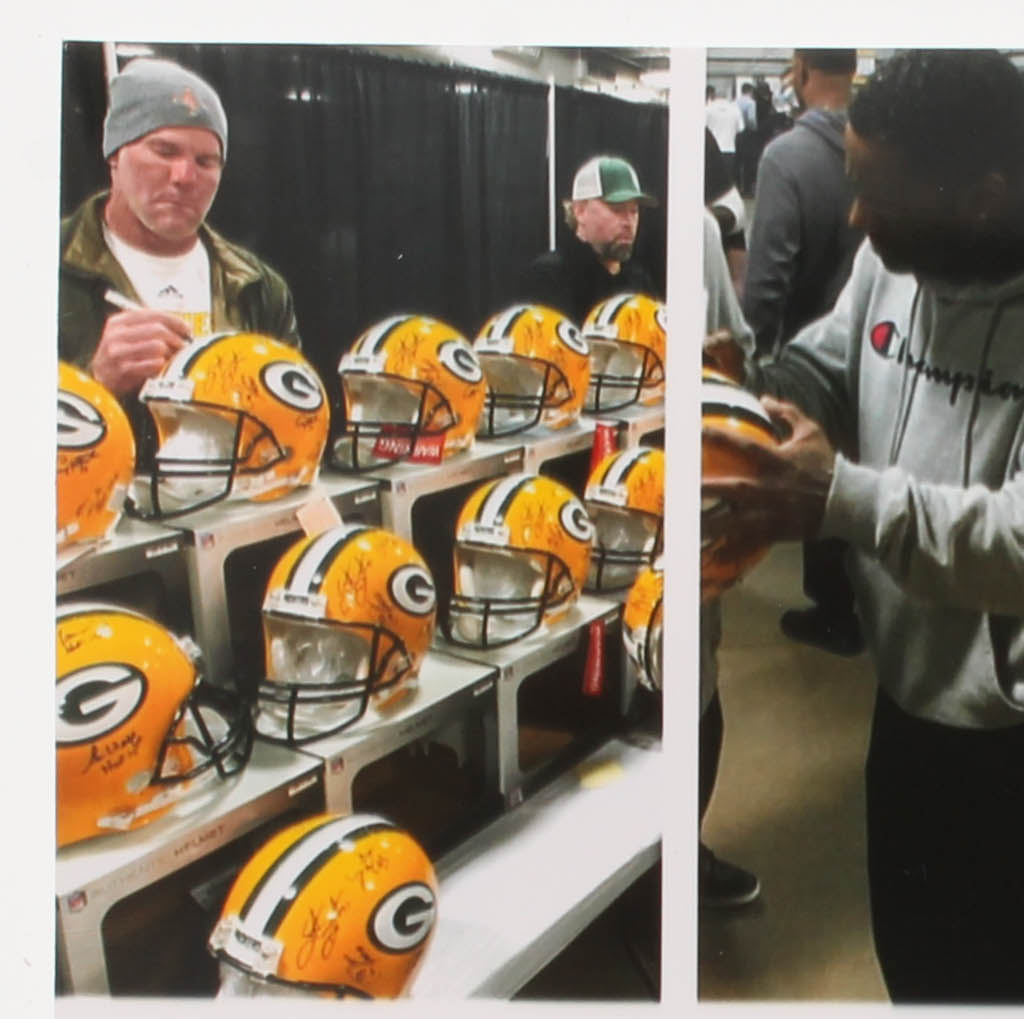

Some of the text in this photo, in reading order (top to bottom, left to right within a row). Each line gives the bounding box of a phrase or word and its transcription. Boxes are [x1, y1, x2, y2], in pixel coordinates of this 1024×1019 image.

[264, 362, 323, 410] G
[391, 566, 436, 614] G
[56, 665, 142, 742] G
[373, 884, 436, 949] G
